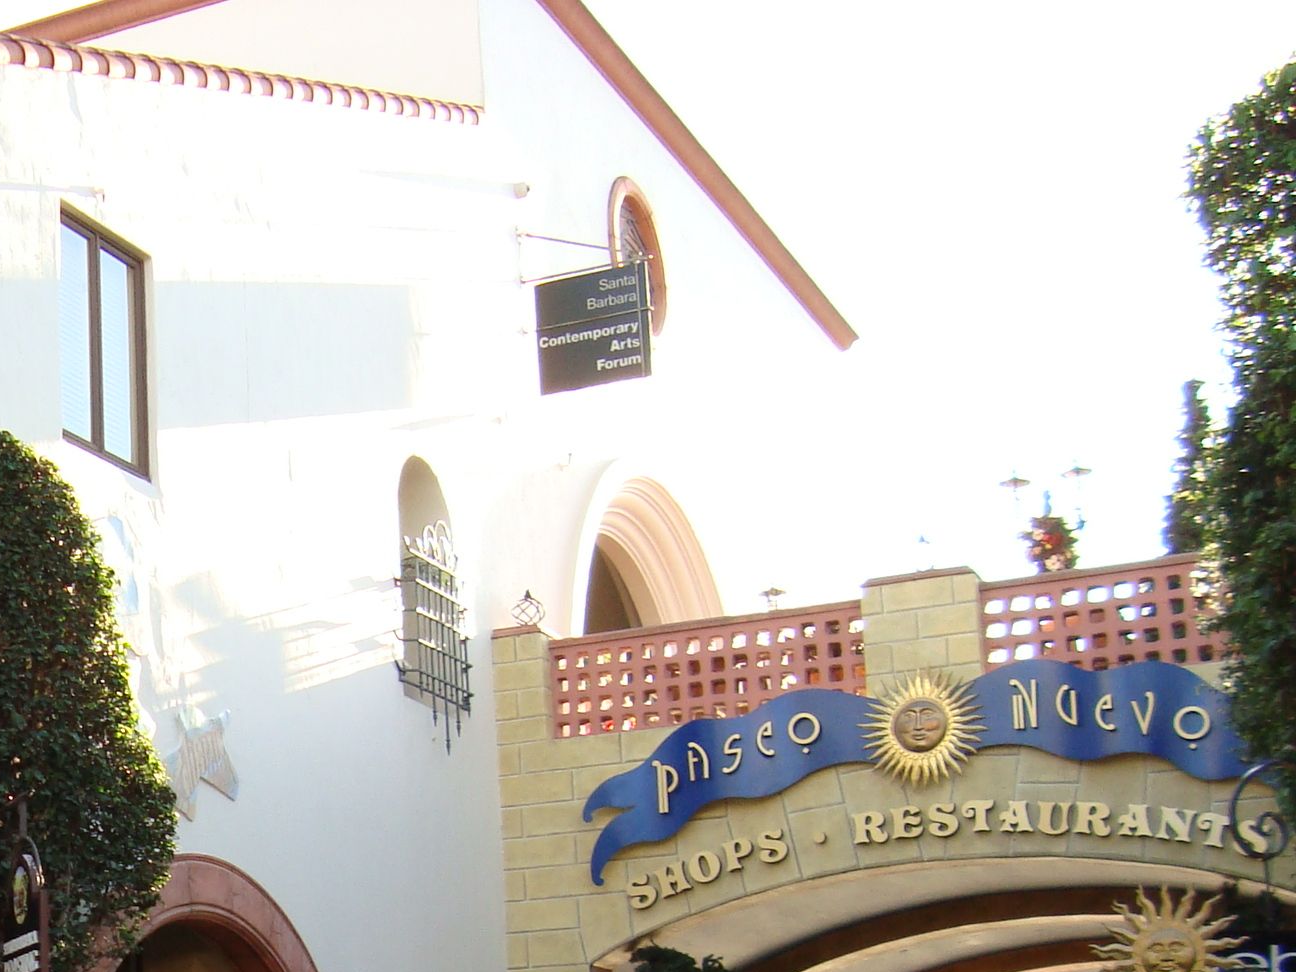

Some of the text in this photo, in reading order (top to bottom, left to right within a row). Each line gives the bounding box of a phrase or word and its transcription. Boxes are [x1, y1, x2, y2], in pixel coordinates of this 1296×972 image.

[599, 275, 636, 291] Santa
[587, 291, 637, 310] Barbara
[539, 321, 639, 348] Contemporary
[610, 337, 641, 352] Arts
[597, 354, 642, 371] Forum
[627, 800, 1272, 911] SHOPS RESTAURANTS
